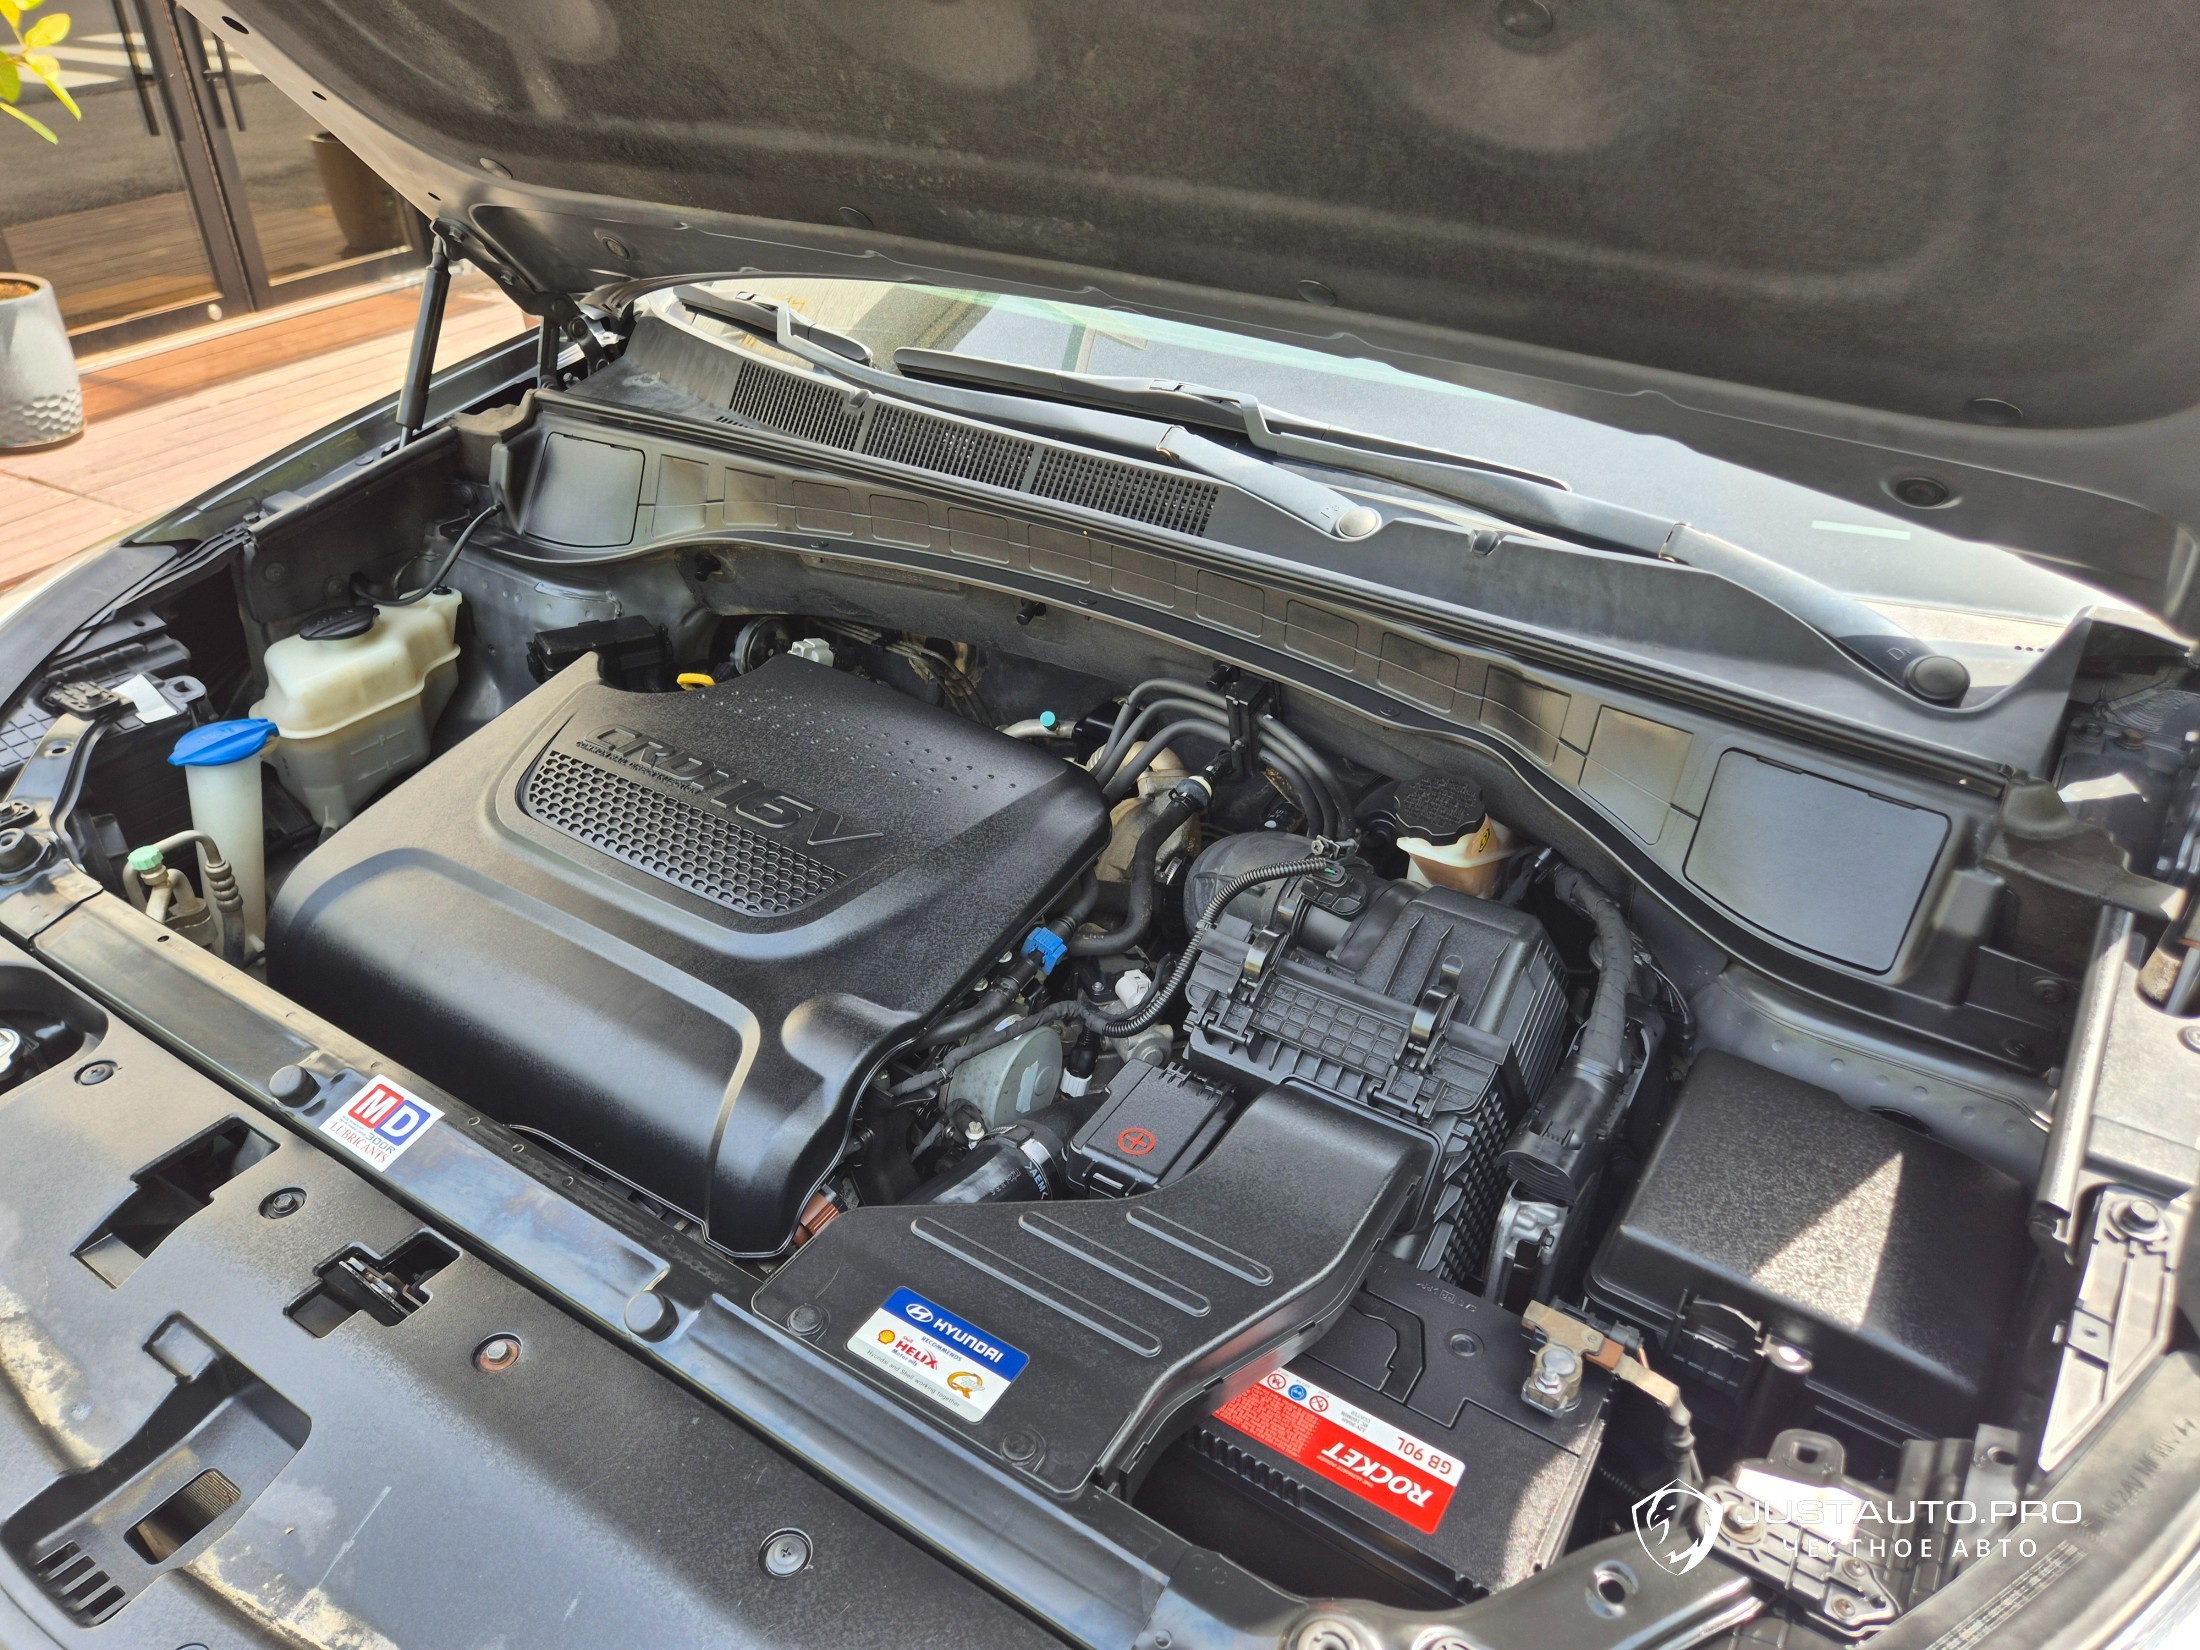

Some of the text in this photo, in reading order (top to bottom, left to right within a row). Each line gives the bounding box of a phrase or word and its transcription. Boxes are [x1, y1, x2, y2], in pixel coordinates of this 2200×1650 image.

[710, 777, 884, 847] 16V
[329, 1121, 389, 1163] LUBRICANTS
[367, 1133, 396, 1154] 300R
[891, 1349, 908, 1363] Motor
[895, 1339, 939, 1371] HELIX
[920, 1336, 963, 1363] RECOMMENDS
[932, 1318, 1004, 1364] HYUNDAI
[866, 1349, 889, 1367] Hyundai
[888, 1361, 901, 1374] and
[900, 1366, 916, 1381] Shell
[914, 1376, 937, 1396] working
[936, 1390, 961, 1409] together
[1321, 1441, 1434, 1508] ROCKET
[1396, 1436, 1452, 1475] GB 90L
